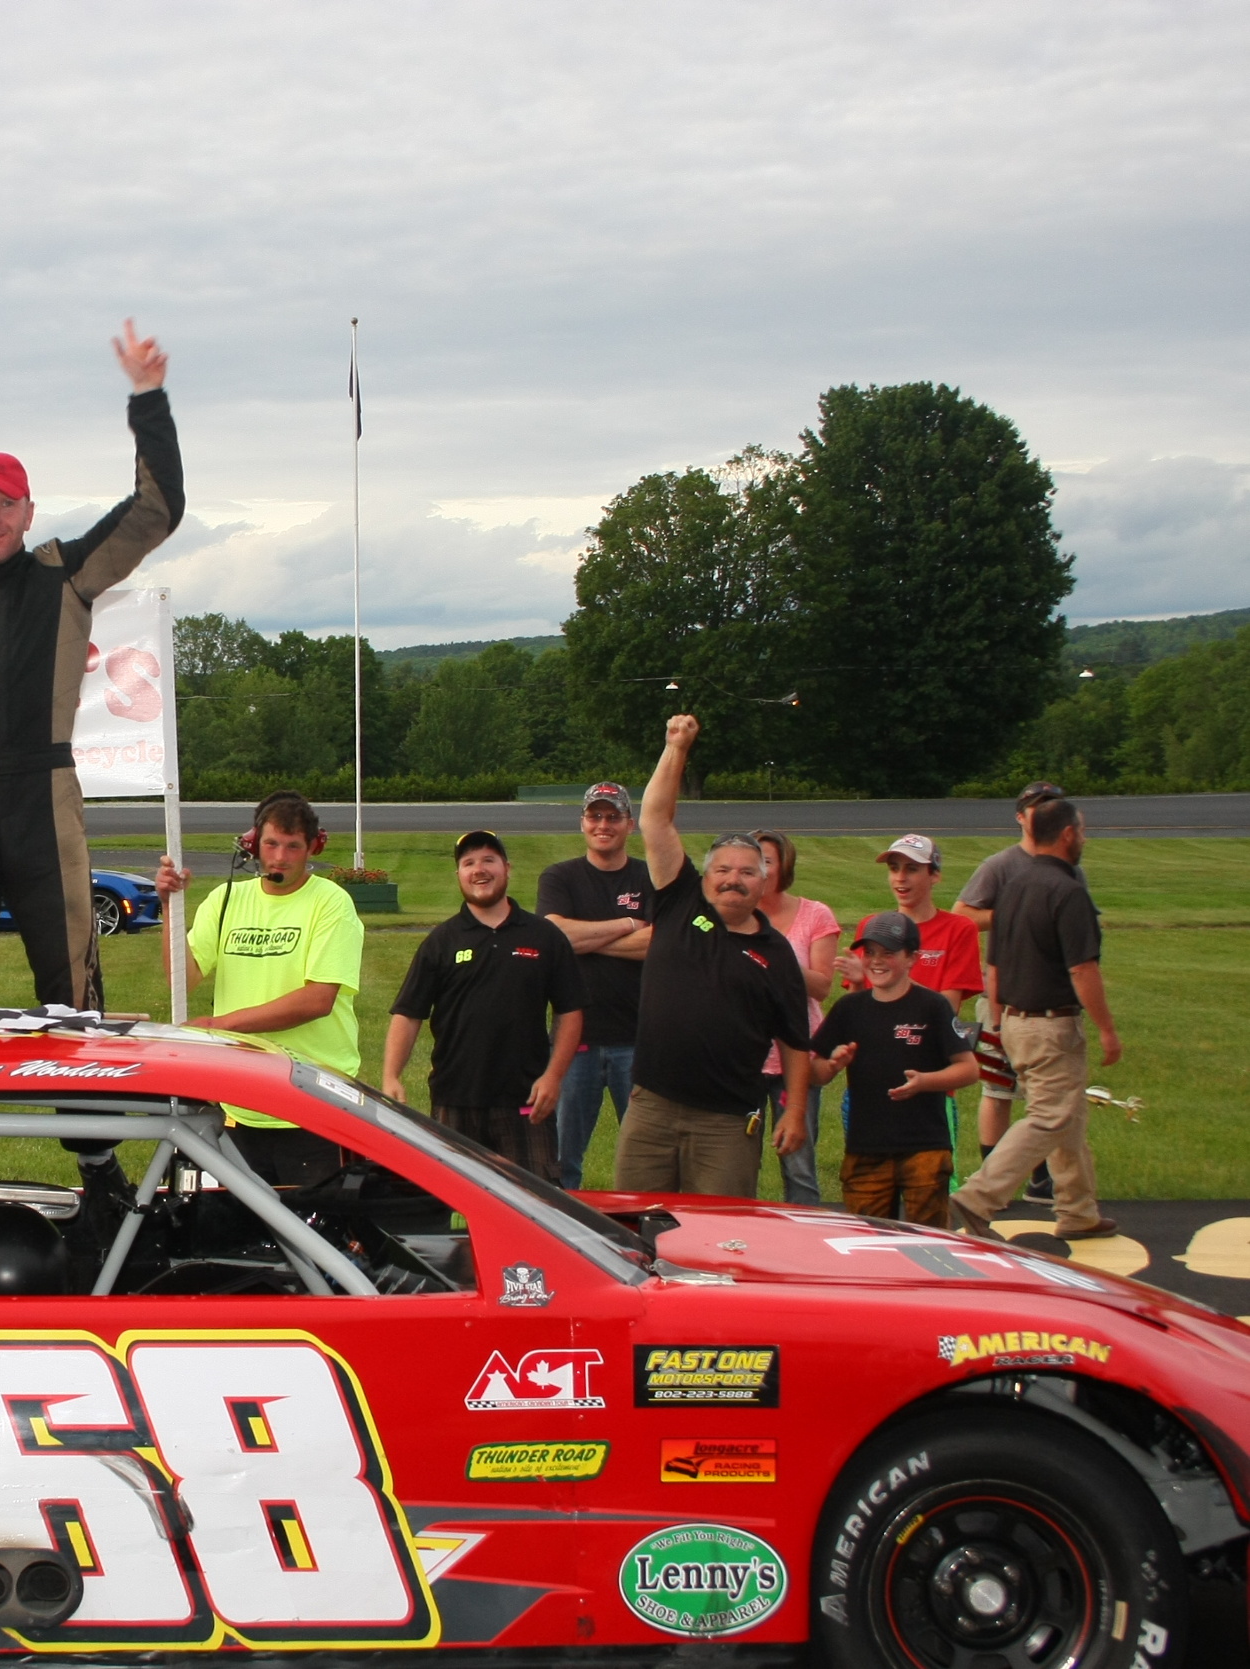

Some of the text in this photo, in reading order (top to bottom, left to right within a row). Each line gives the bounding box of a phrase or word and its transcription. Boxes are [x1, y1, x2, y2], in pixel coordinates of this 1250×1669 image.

[692, 915, 714, 932] 68
[230, 932, 270, 945] THUNDR
[455, 949, 473, 963] 68
[10, 1059, 143, 1078] Woodard
[505, 1279, 544, 1294] FIVE STAR
[950, 1331, 1112, 1367] AMERICAN
[645, 1350, 773, 1371] FAST ONE
[993, 1354, 1075, 1366] RACER
[465, 1349, 604, 1400] ACT
[647, 1372, 765, 1386] MOTORSPORTS
[654, 1390, 754, 1398] 802-223-5888
[476, 1448, 597, 1464] THUNDER ROAD
[672, 1532, 691, 1543] Fit
[692, 1531, 714, 1540] You
[819, 1450, 931, 1627] AMERICAN
[635, 1555, 775, 1600] Lenny's
[637, 1595, 769, 1627] SHOE & APPAREL
